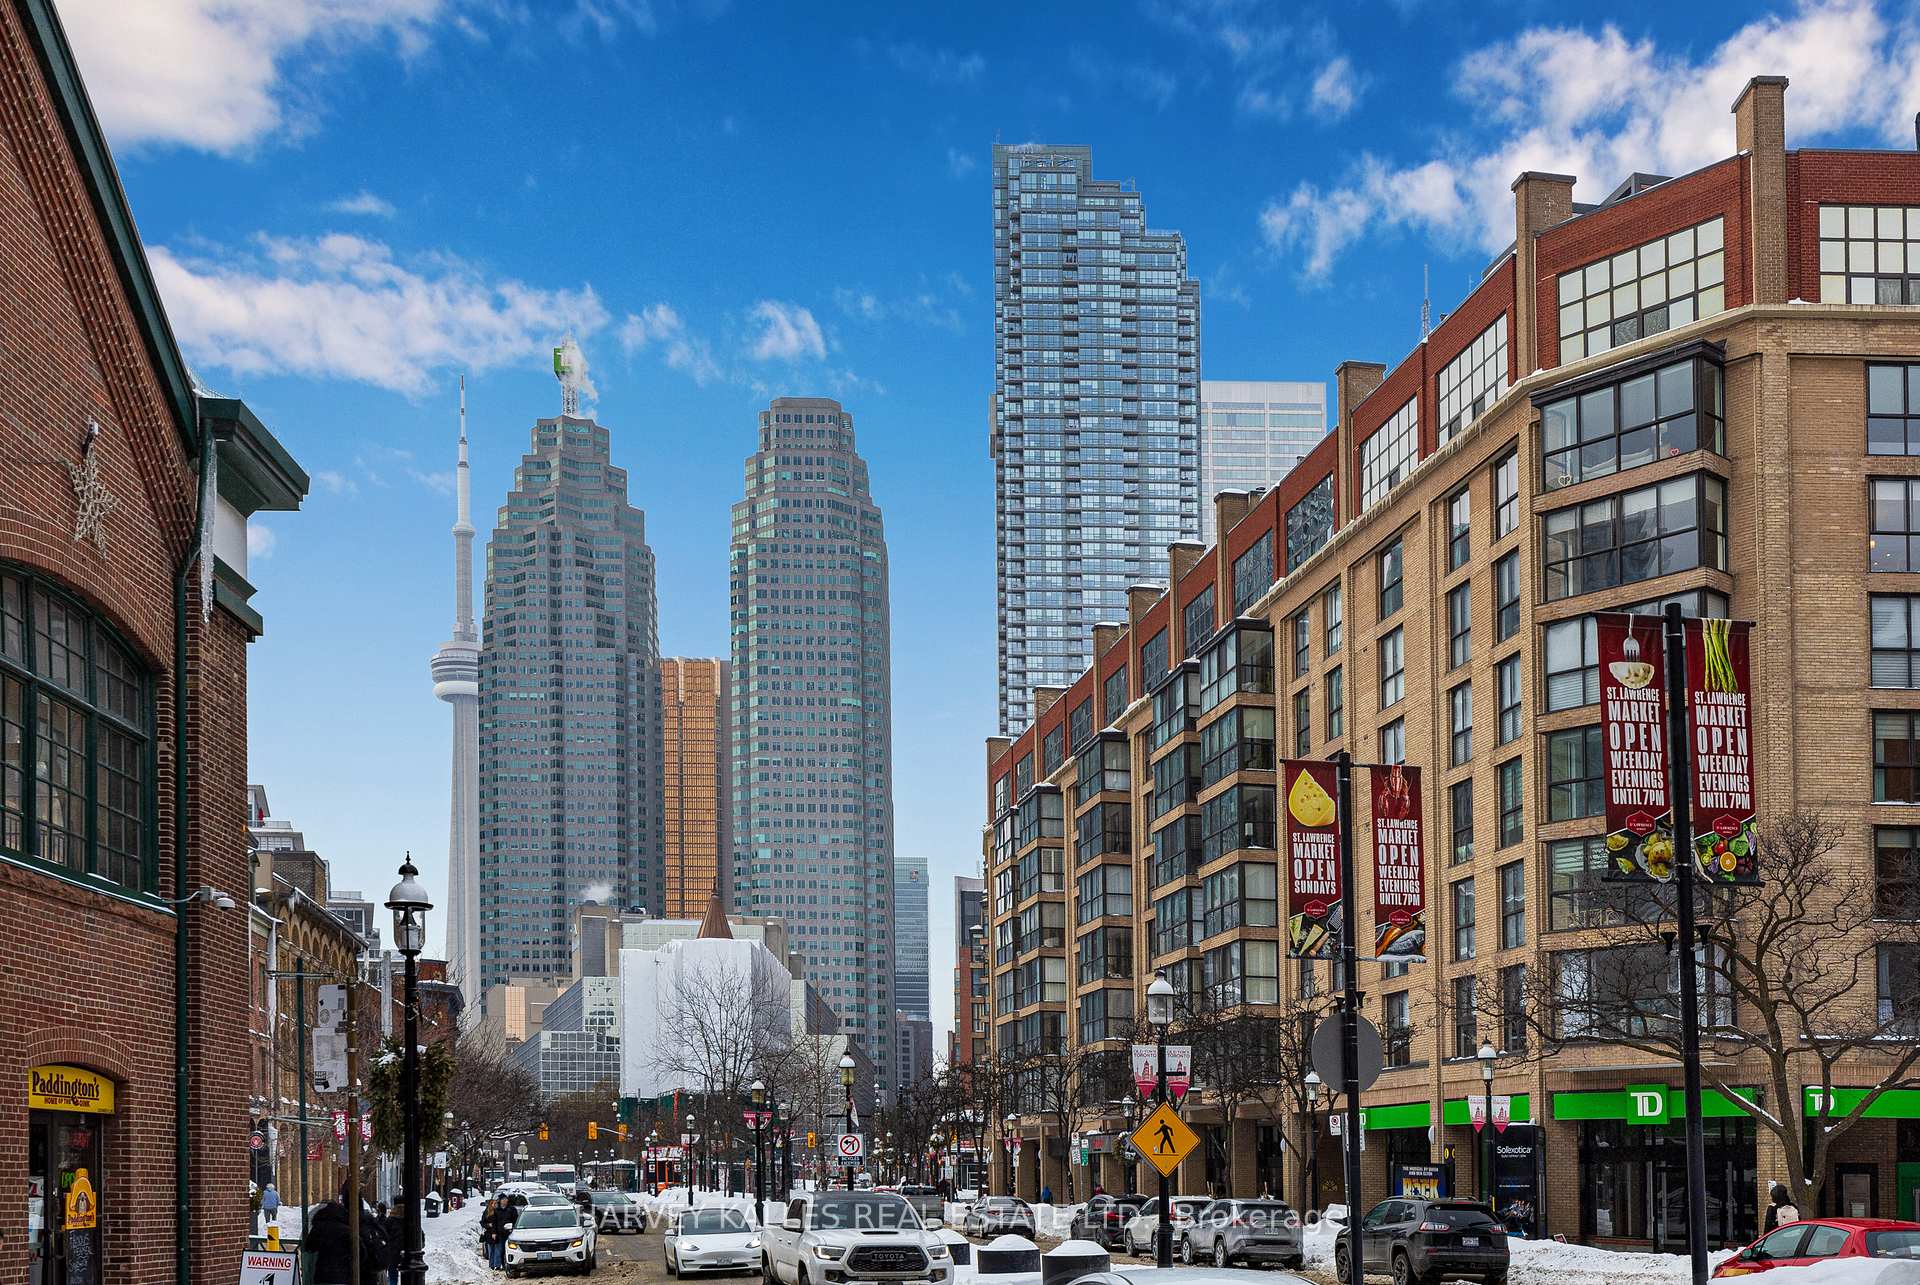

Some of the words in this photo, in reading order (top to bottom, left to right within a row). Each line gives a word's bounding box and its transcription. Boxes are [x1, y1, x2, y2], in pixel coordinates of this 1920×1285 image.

[1607, 687, 1619, 699] ST.
[1620, 687, 1659, 702] LAWRENCE
[1695, 692, 1707, 704] ST.
[1708, 692, 1746, 706] LAWRENCE
[1608, 701, 1660, 722] MARKET
[1696, 705, 1746, 727] MARKET
[1609, 722, 1661, 752] OPEN
[1697, 727, 1748, 756] OPEN
[1610, 751, 1662, 770] WEEKDAY
[1698, 755, 1748, 774] WEEKDAY
[1611, 769, 1664, 789] EVENINGS
[1699, 773, 1749, 793] EVENINGS
[1612, 788, 1643, 805] UNTIL
[1643, 789, 1665, 806] 7PM
[1700, 792, 1728, 809] UNTIL
[1729, 793, 1750, 810] 7PM
[1377, 819, 1386, 828] ST.
[1387, 818, 1418, 829] LAWRENCE
[1292, 833, 1303, 842] ST.
[1303, 833, 1335, 844] LAWRENCE
[1378, 829, 1418, 845] MARKET
[1293, 843, 1335, 859] MARKET
[1378, 845, 1419, 866] OPEN
[1294, 859, 1336, 881] OPEN
[1379, 865, 1420, 879] WEEKDAY
[1294, 880, 1336, 895] SUNDAYS
[1379, 879, 1420, 893] EVENINGS
[1380, 892, 1403, 905] UNTIL
[1403, 893, 1420, 906] 7PM
[32, 1071, 100, 1097] Paddington's
[1630, 1092, 1663, 1117] TD
[1403, 1178, 1440, 1199] ROCK
[248, 1256, 291, 1268] WARNING
